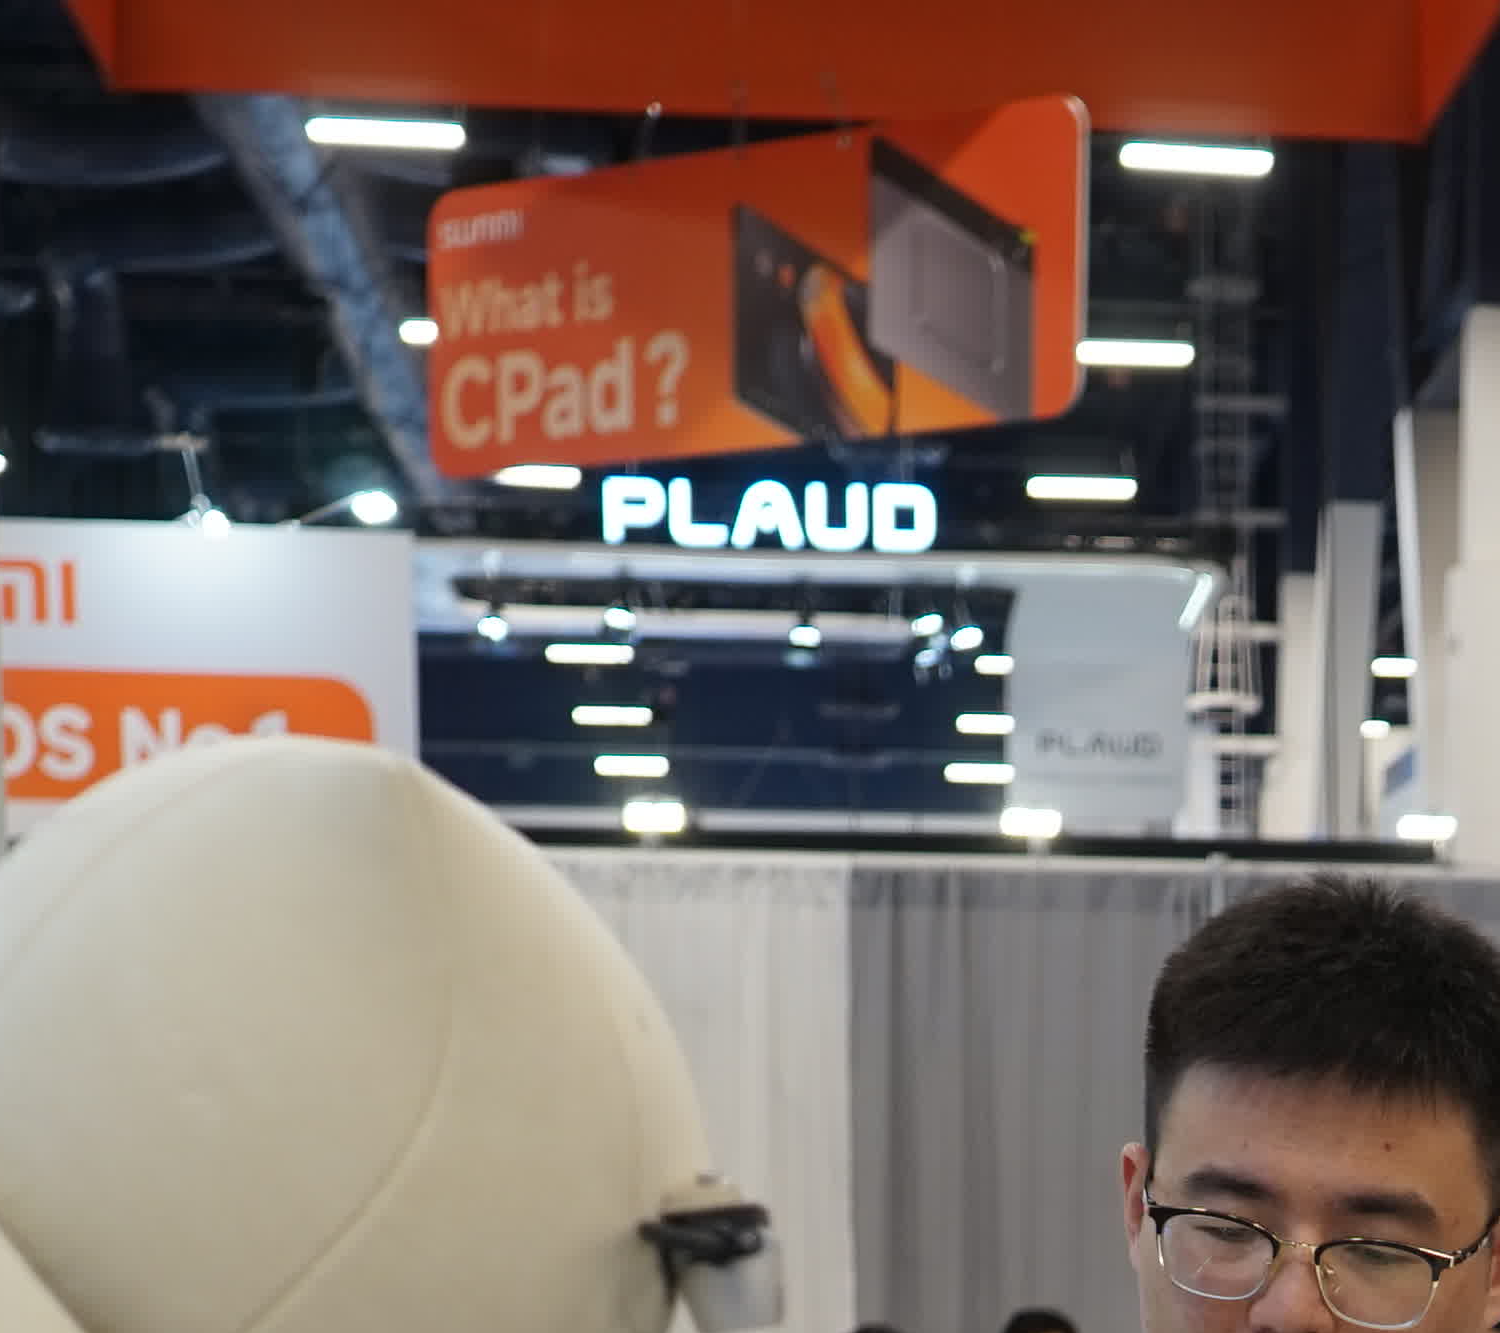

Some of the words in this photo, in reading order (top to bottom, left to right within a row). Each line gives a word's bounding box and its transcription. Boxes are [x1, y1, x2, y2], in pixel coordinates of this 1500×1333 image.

[438, 272, 564, 341] What
[572, 258, 614, 324] is
[602, 474, 938, 553] PLAUD
